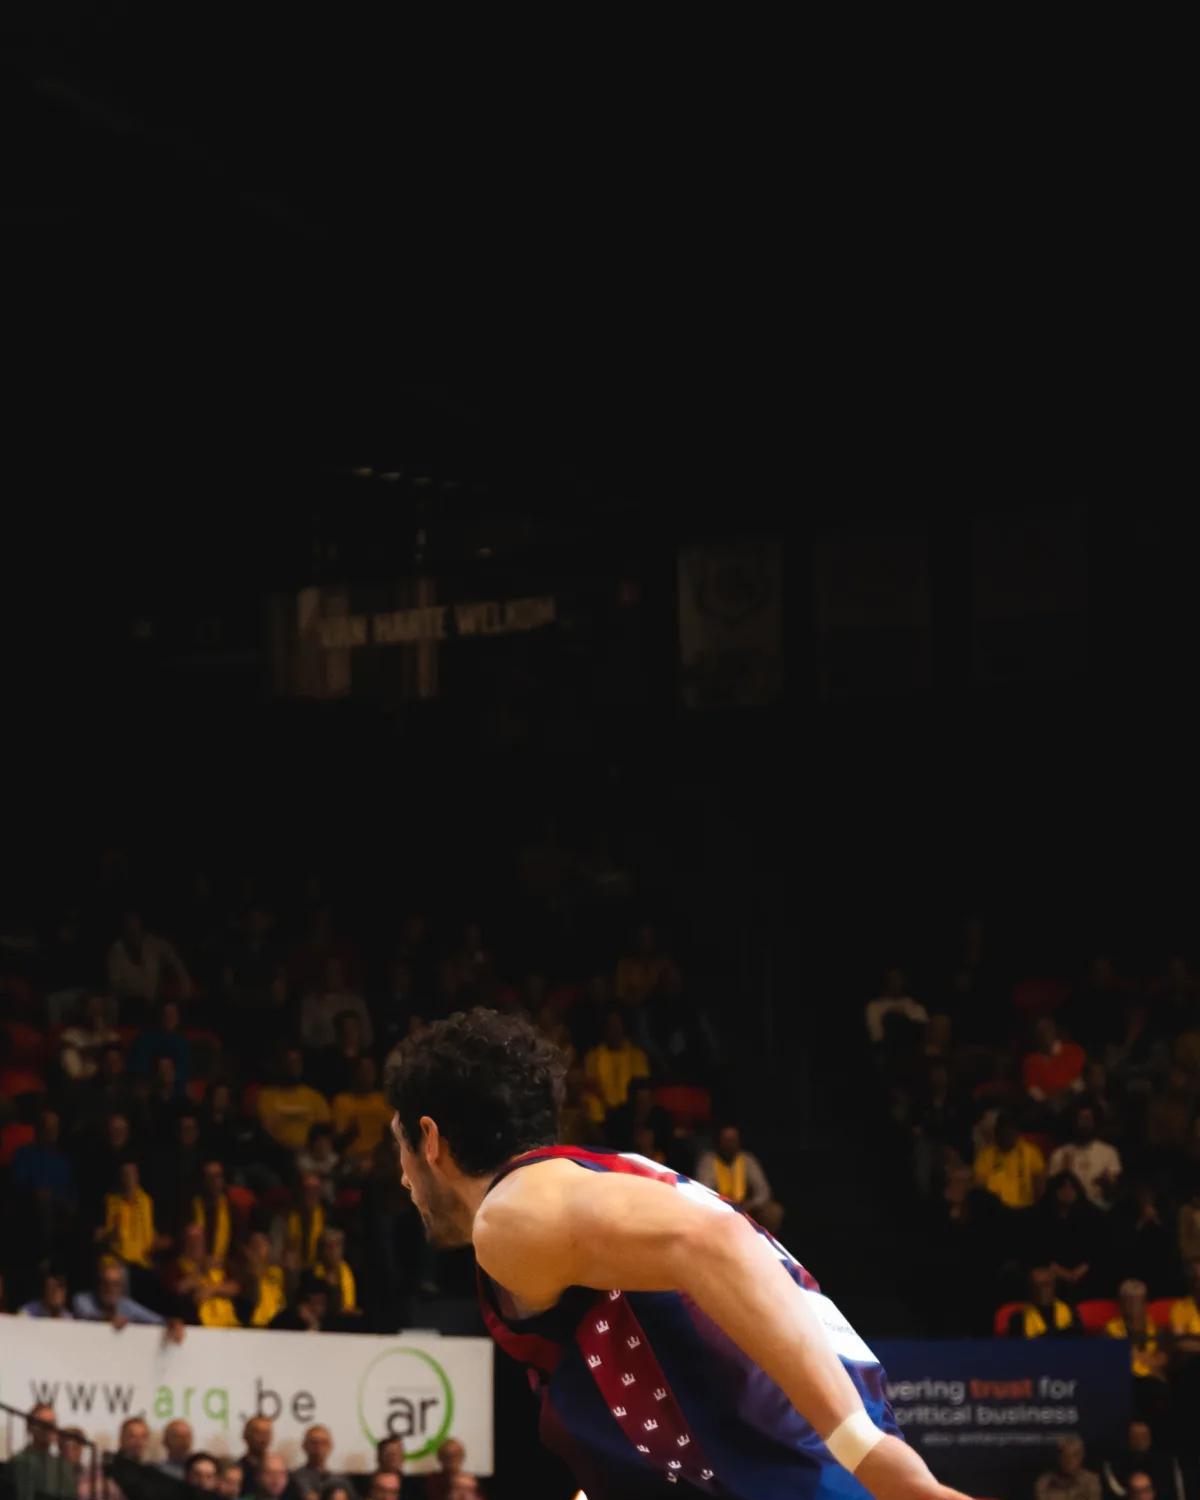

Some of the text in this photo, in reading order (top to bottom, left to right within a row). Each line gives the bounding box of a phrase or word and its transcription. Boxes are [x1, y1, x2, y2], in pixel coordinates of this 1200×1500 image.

[970, 1378, 1033, 1398] trust
[1038, 1376, 1078, 1398] for
[976, 1404, 1079, 1424] business
